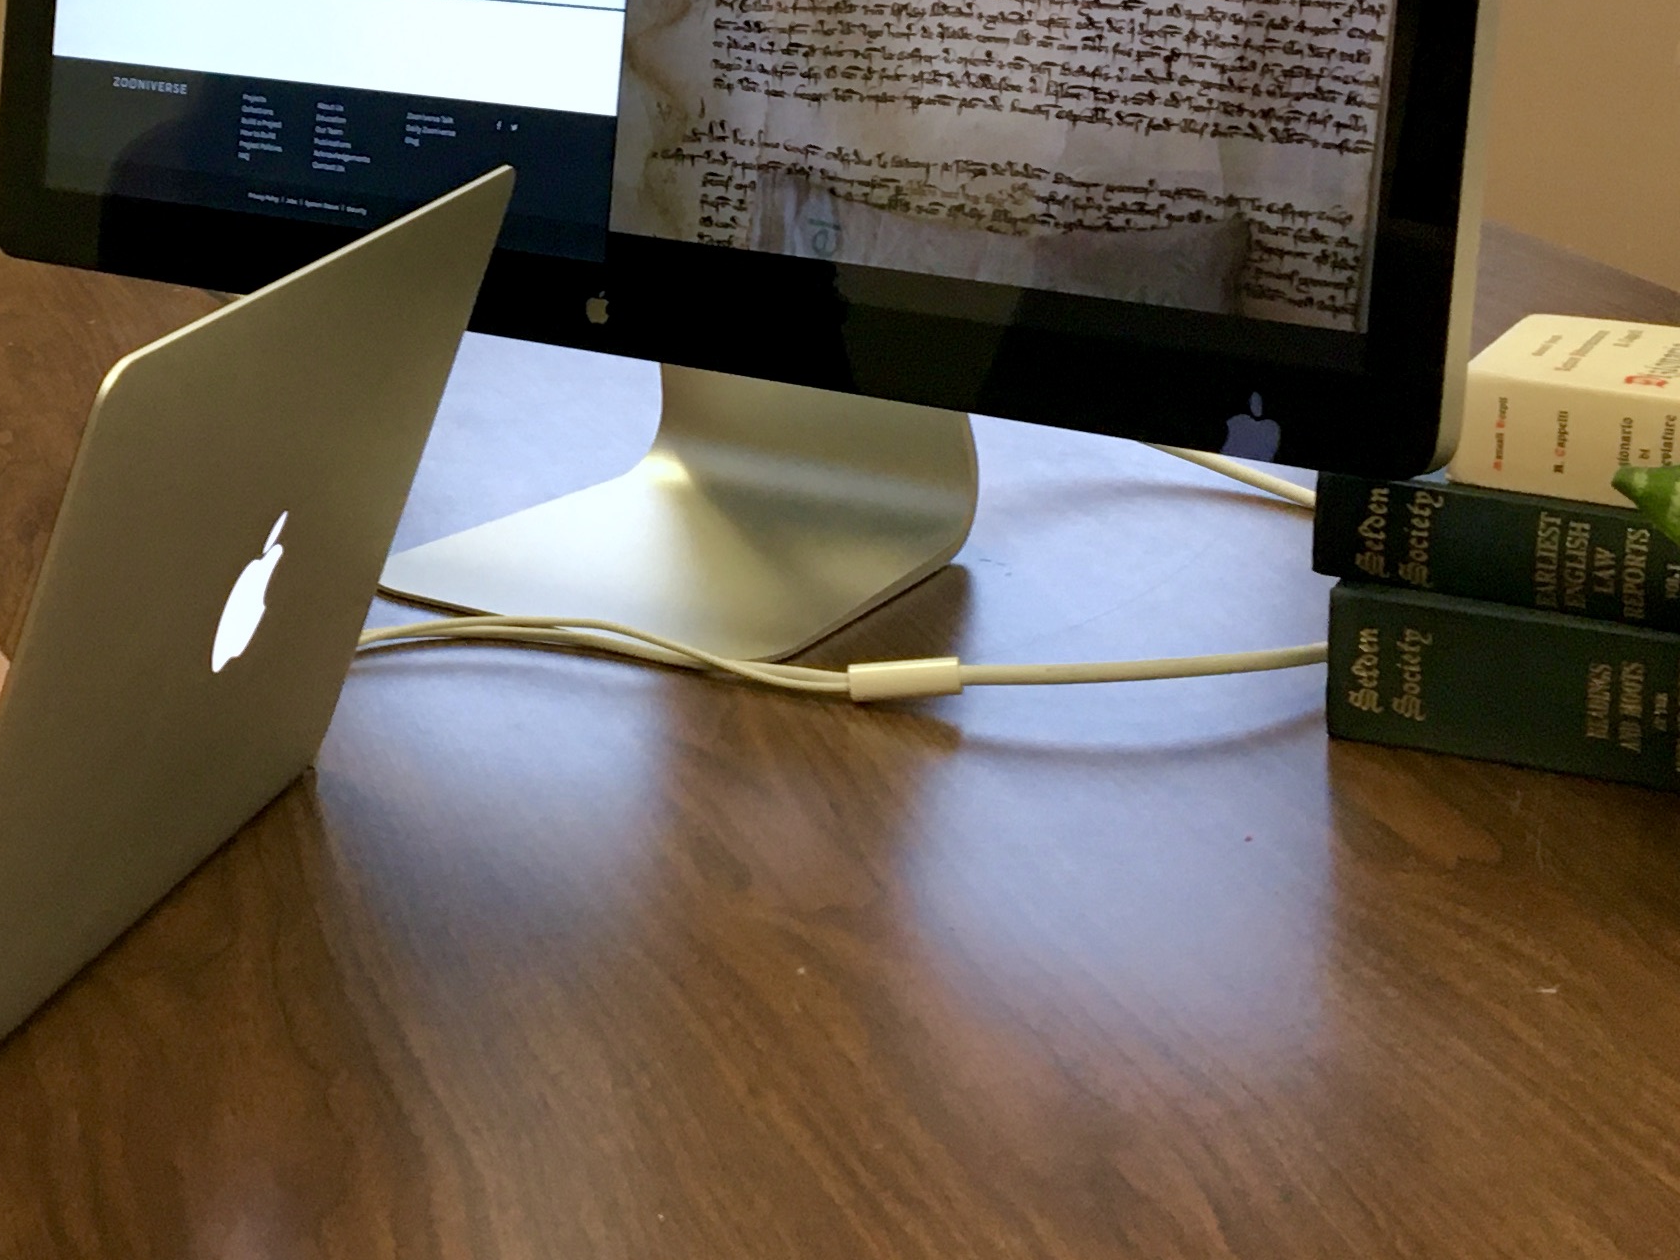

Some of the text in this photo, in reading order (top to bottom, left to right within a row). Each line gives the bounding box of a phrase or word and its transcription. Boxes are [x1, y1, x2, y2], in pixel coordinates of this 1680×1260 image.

[112, 76, 189, 96] ZOONIVERSE
[1492, 431, 1506, 472] Manuali
[1553, 409, 1569, 458] Cappelli
[1354, 486, 1391, 580] Selden
[1398, 488, 1445, 588] Society
[1535, 511, 1564, 610] EARLIEST
[1563, 520, 1593, 610] ENGLISH
[1594, 544, 1618, 596] LAW
[1622, 527, 1652, 621] REPORTS
[1347, 626, 1380, 714] Selden
[1391, 626, 1434, 722] Society
[1585, 662, 1613, 741] READINGS
[1619, 660, 1645, 753] AND MOOTS
